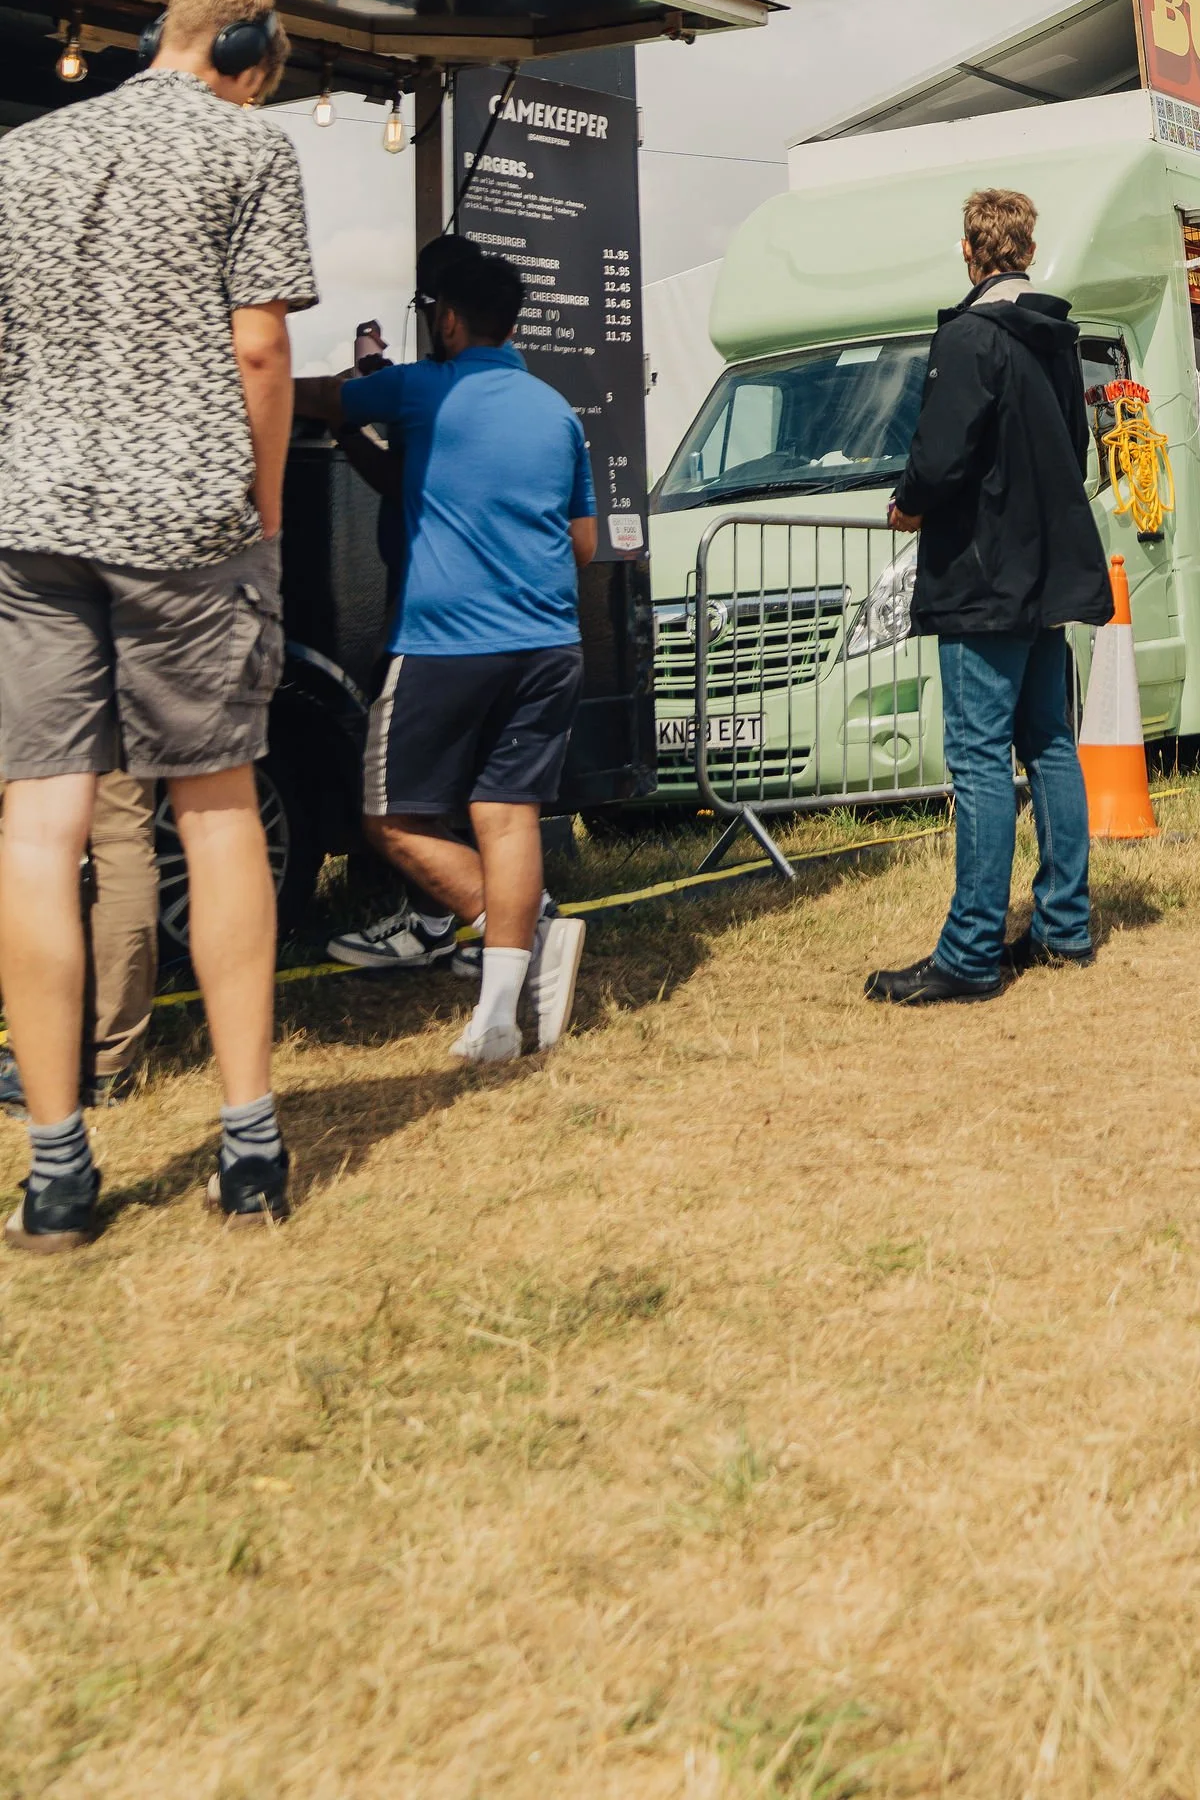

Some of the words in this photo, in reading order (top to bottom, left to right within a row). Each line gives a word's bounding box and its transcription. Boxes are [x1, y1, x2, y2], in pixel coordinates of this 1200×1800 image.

[488, 94, 609, 140] GAMEKEEPER
[465, 230, 527, 248] CHEESEBURGER
[602, 248, 629, 260] 11.95
[603, 265, 630, 277] 15.95
[604, 281, 631, 293] 12.45
[529, 291, 590, 306] CHEESEBURGER
[605, 298, 632, 309] 16.45
[605, 314, 632, 326] 11.25
[521, 324, 552, 336] BURGER
[605, 331, 632, 342] 11.75
[606, 392, 613, 403] 5
[609, 469, 616, 480] 5
[610, 483, 617, 493] 5
[719, 717, 761, 741] EZT
